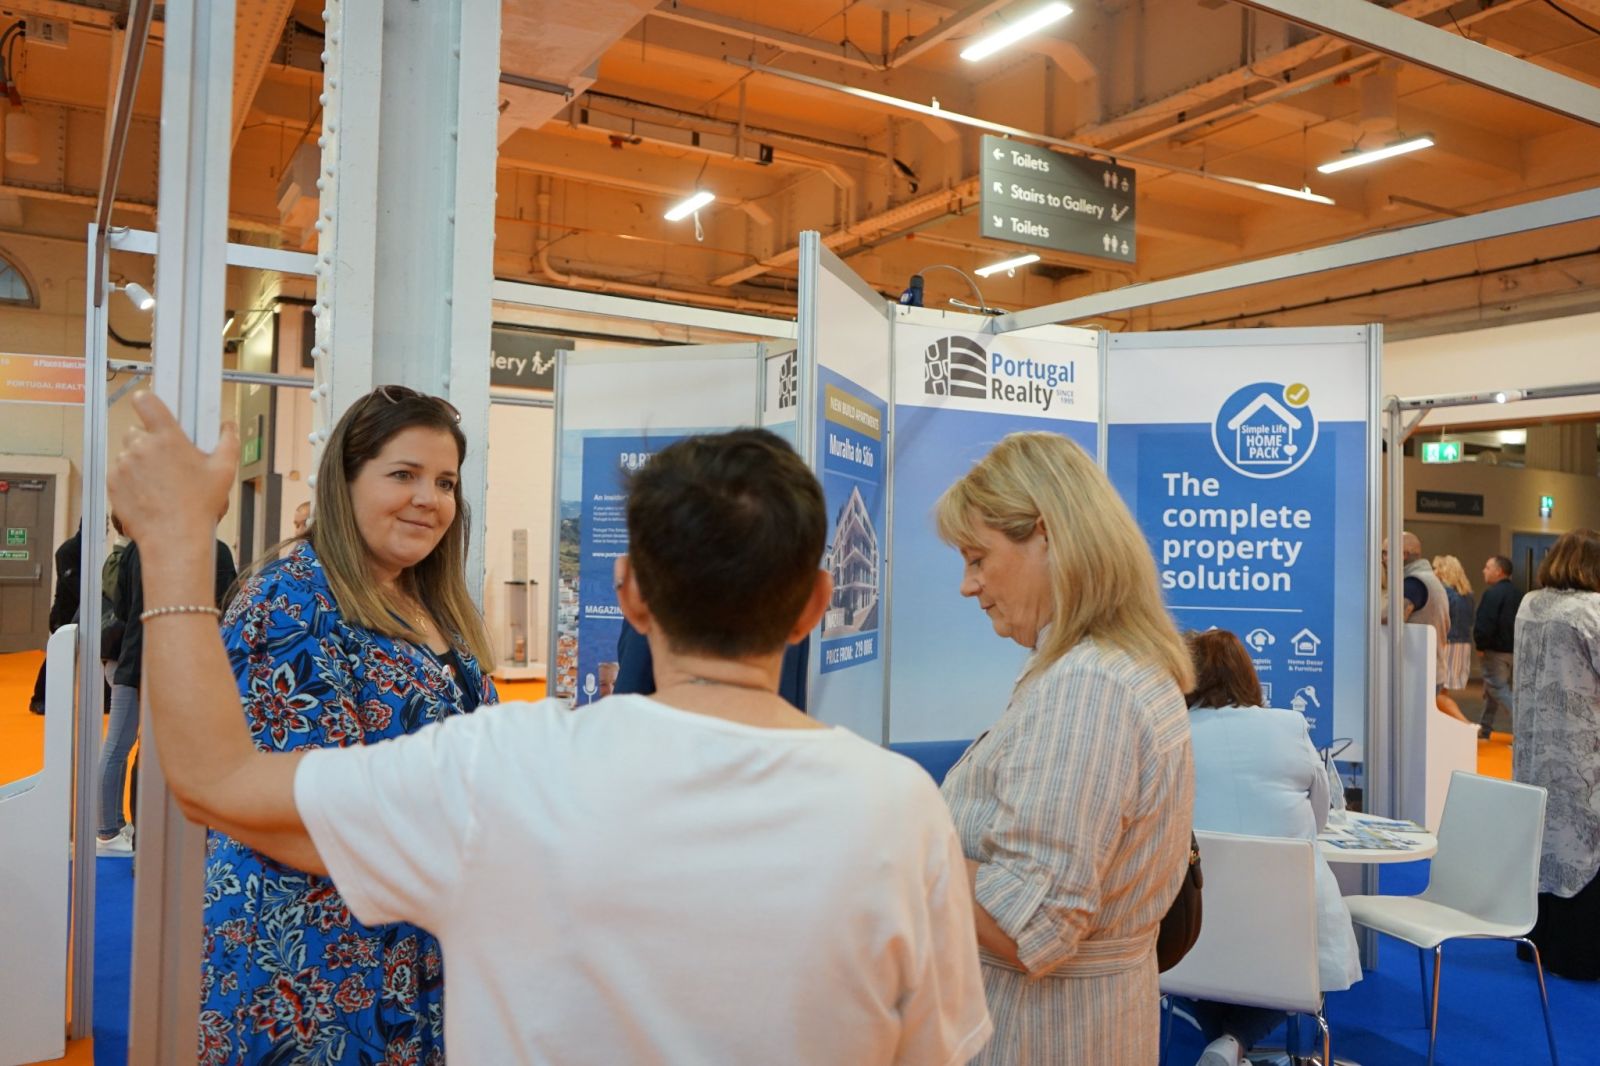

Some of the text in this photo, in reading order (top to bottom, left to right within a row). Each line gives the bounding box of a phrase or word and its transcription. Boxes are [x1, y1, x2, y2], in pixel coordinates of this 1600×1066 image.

[1010, 150, 1050, 173] Toilets
[1011, 184, 1104, 220] Stairs to Gallery
[1010, 217, 1050, 238] Toilets
[491, 350, 528, 376] lery
[992, 352, 1074, 388] Portugal
[6, 379, 54, 390] PORTUGAL
[992, 378, 1074, 411] Realty SINCE
[1241, 424, 1287, 436] Simple Life
[1246, 435, 1282, 447] HOME
[829, 433, 854, 461] Muralha
[855, 442, 863, 465] do
[1249, 446, 1279, 459] PACK
[1162, 471, 1220, 497] The
[1162, 502, 1312, 535] complete
[1163, 537, 1303, 567] property
[1161, 564, 1291, 592] solution
[585, 604, 623, 615] MAGAZIN
[1287, 658, 1305, 666] Home
[1294, 665, 1323, 673] Furniture
